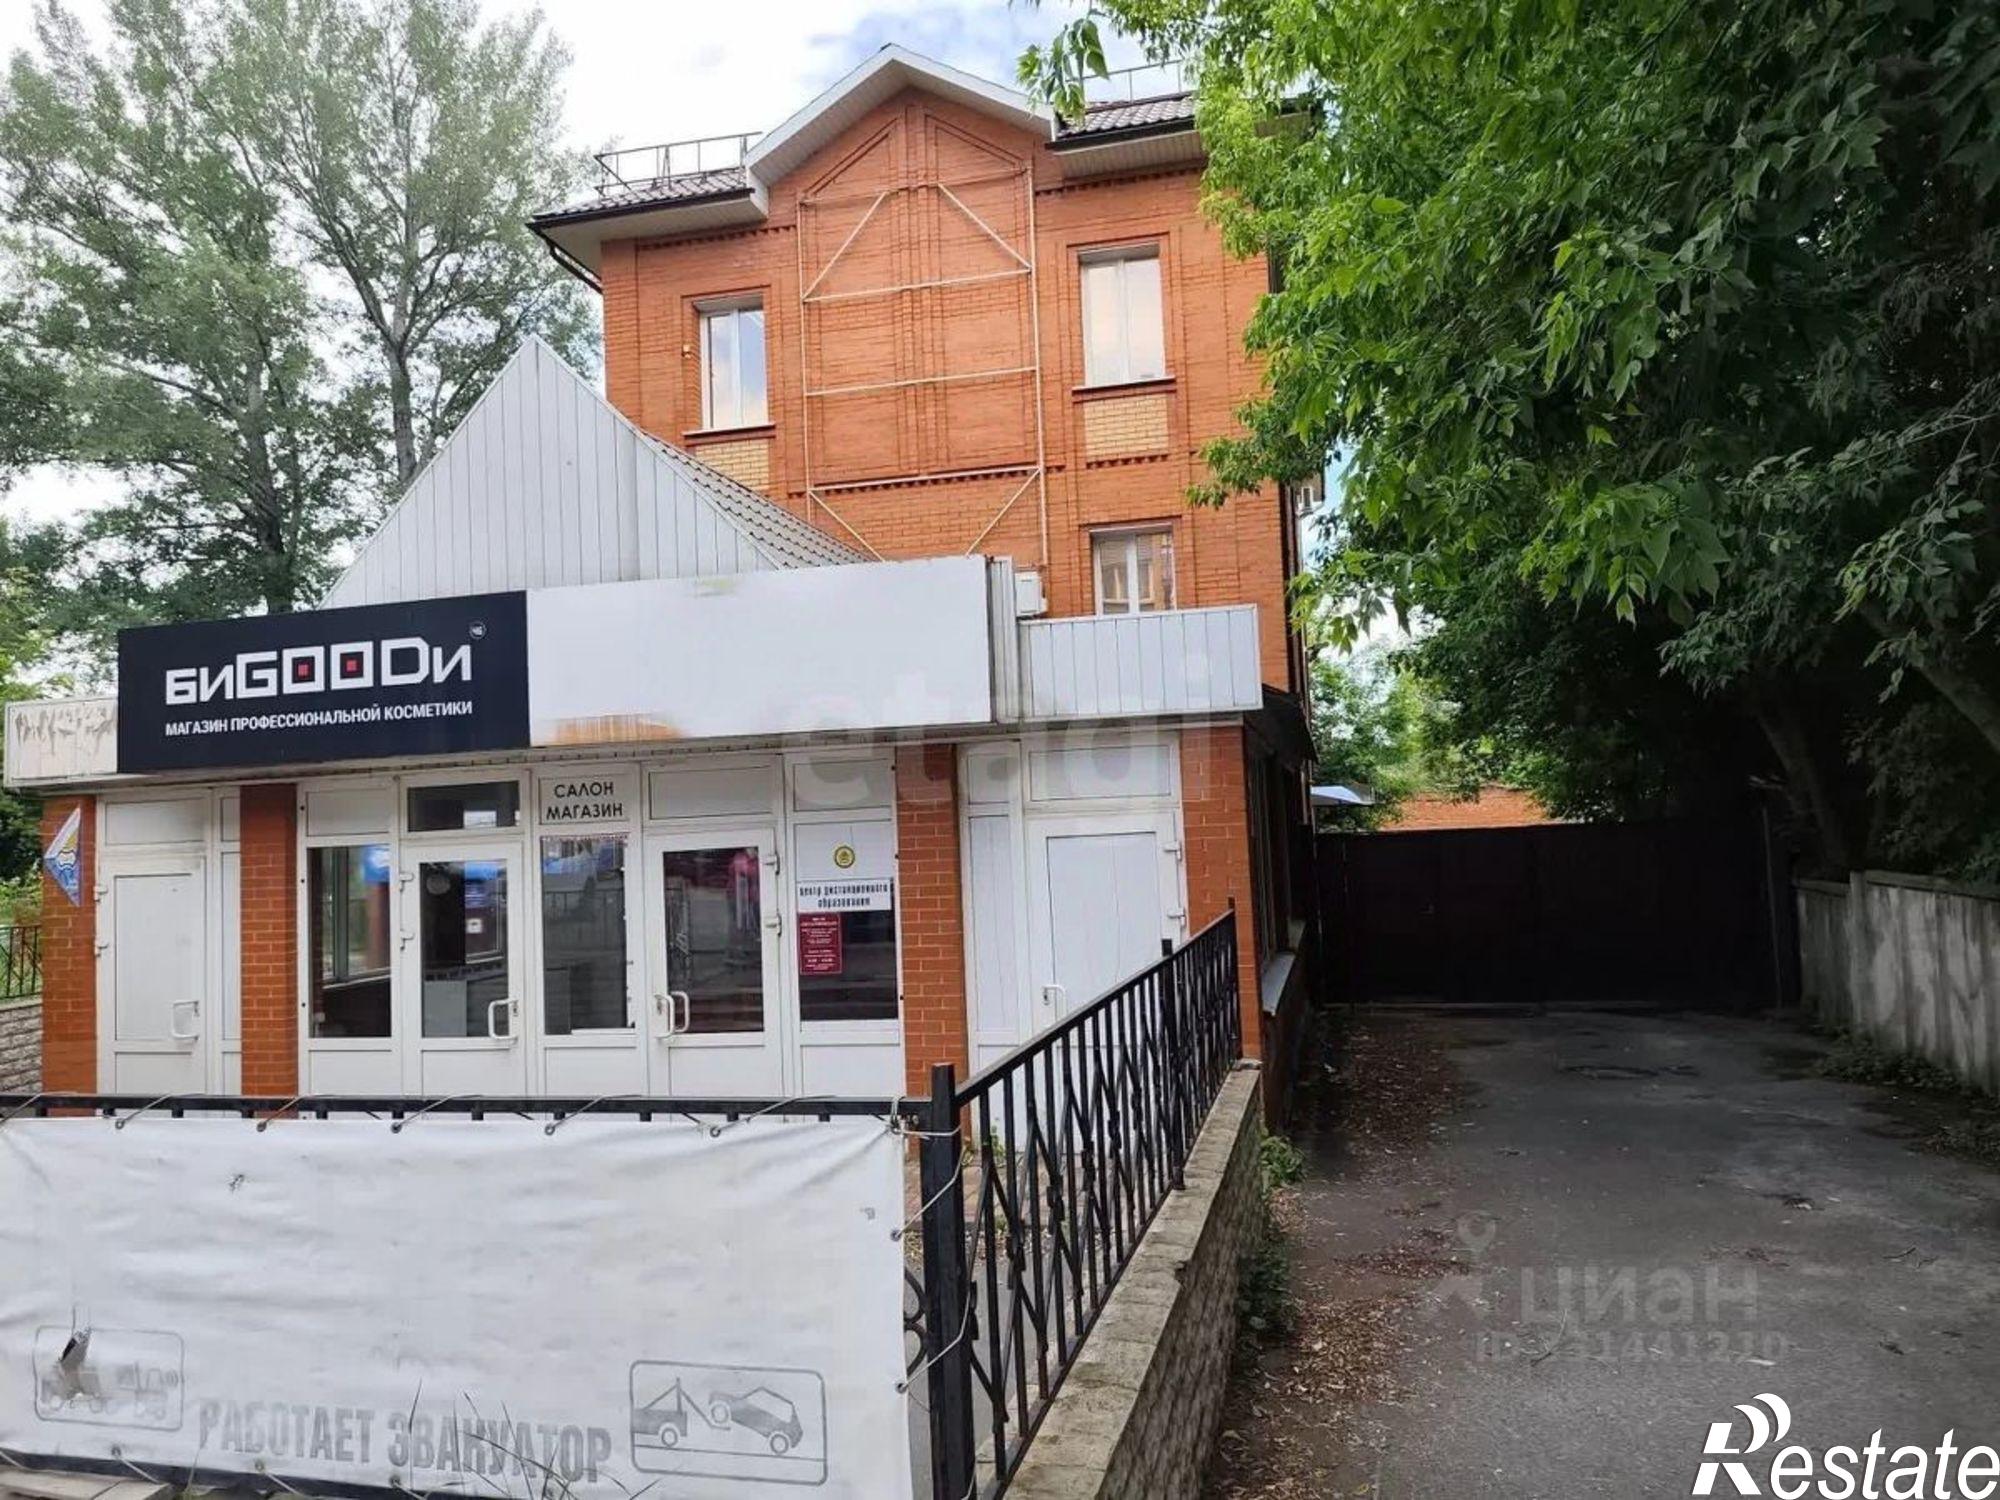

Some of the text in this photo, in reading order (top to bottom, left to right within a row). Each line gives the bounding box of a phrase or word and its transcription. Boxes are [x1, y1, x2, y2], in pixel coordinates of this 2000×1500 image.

[165, 700, 473, 736] МАГАЗИН ПРОФЕССИОНАЛЬНОЙ КОСМЕТИКИ
[553, 781, 614, 799] САЛОН
[546, 802, 623, 821] МАГАЗИН
[200, 1402, 375, 1463] РАБОТАЕТ
